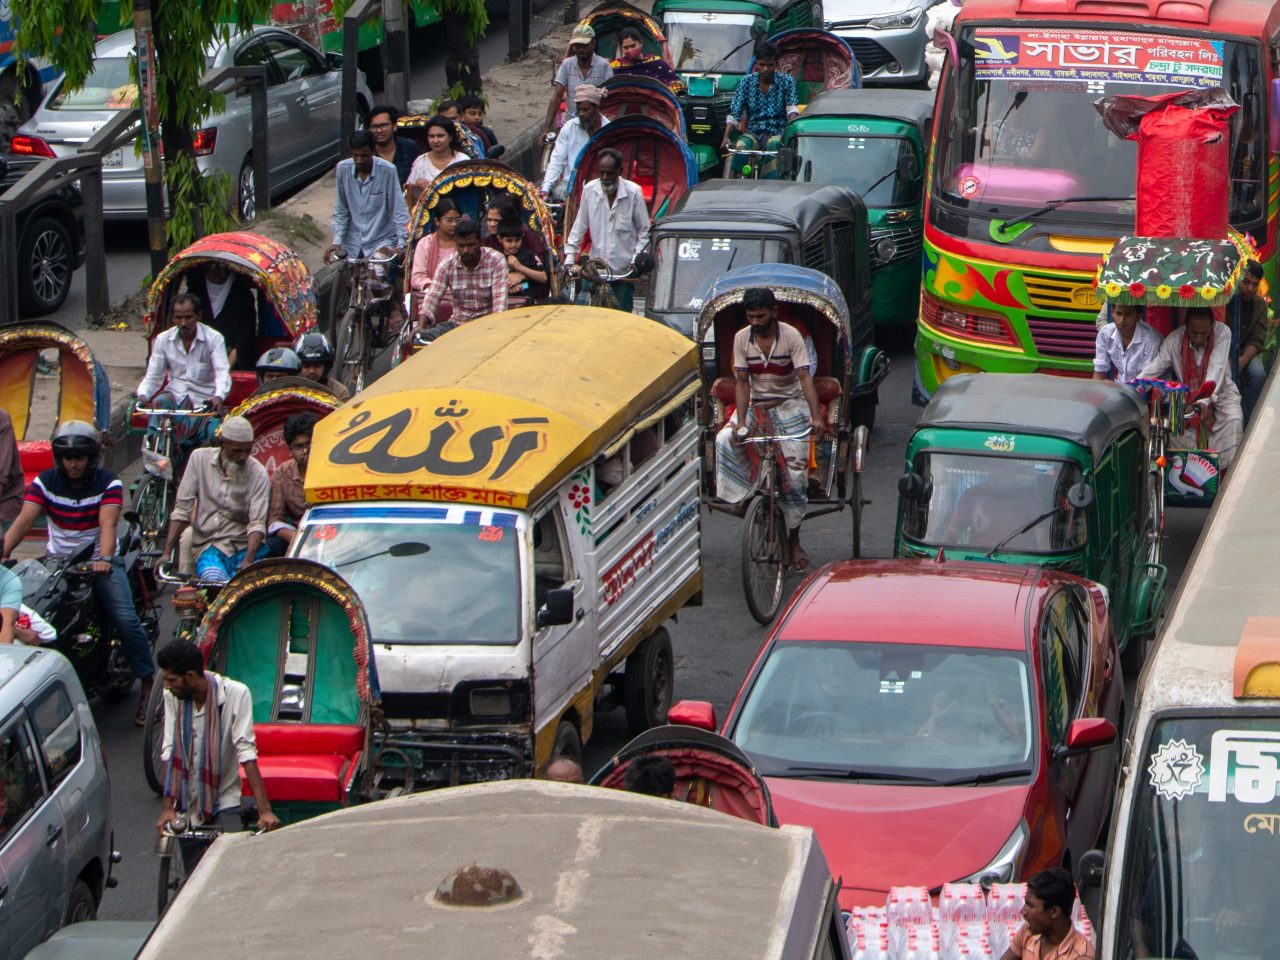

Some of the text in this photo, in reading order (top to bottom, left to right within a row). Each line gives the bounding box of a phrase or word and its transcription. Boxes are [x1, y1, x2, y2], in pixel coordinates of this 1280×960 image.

[1021, 40, 1144, 69] সাভার
[1146, 46, 1219, 62] পরিবহন লিঃ
[678, 242, 699, 259] 0%
[314, 486, 381, 501] আল্লাহ
[383, 481, 413, 500] সর্ব
